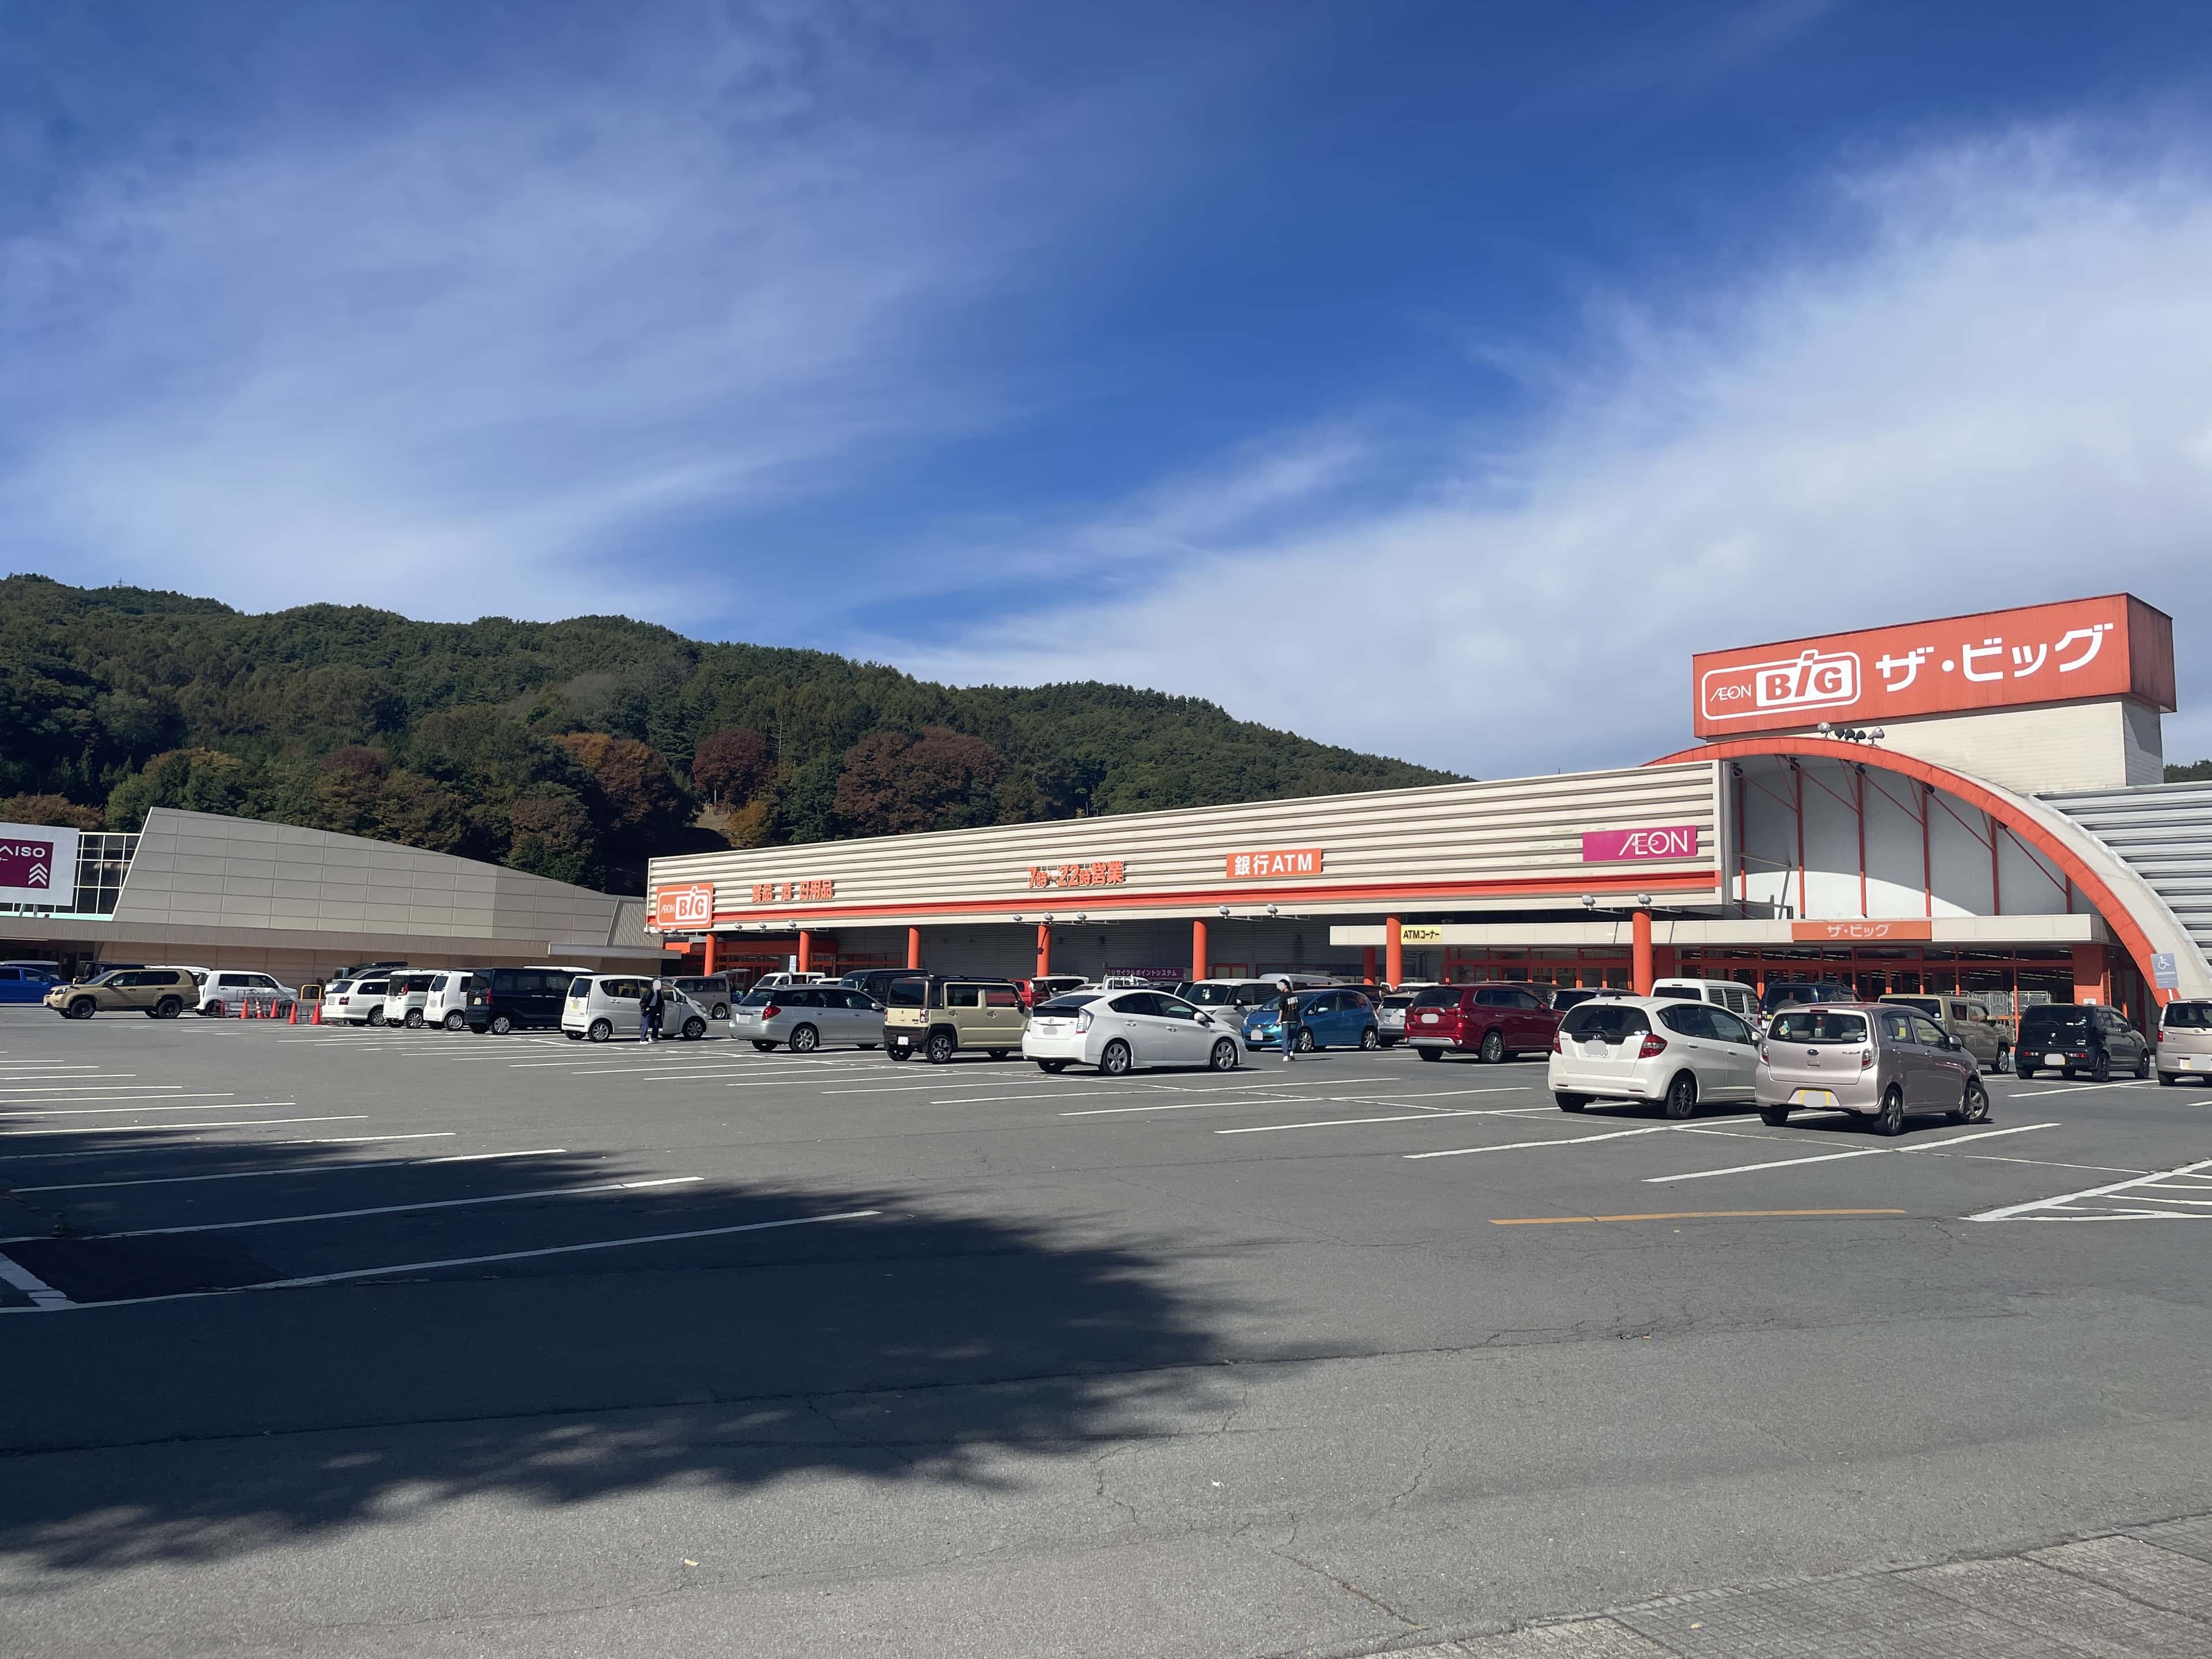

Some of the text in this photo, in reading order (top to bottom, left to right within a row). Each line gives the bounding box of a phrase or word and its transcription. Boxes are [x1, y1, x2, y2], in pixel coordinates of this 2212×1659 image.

[1875, 622, 2114, 692] ザ・ビッグ
[1234, 853, 1312, 876] 銀行ATM
[800, 880, 833, 900] 日用品
[1403, 929, 1440, 940] ATMコーナー
[1827, 923, 1891, 938] ザ・ビッグ
